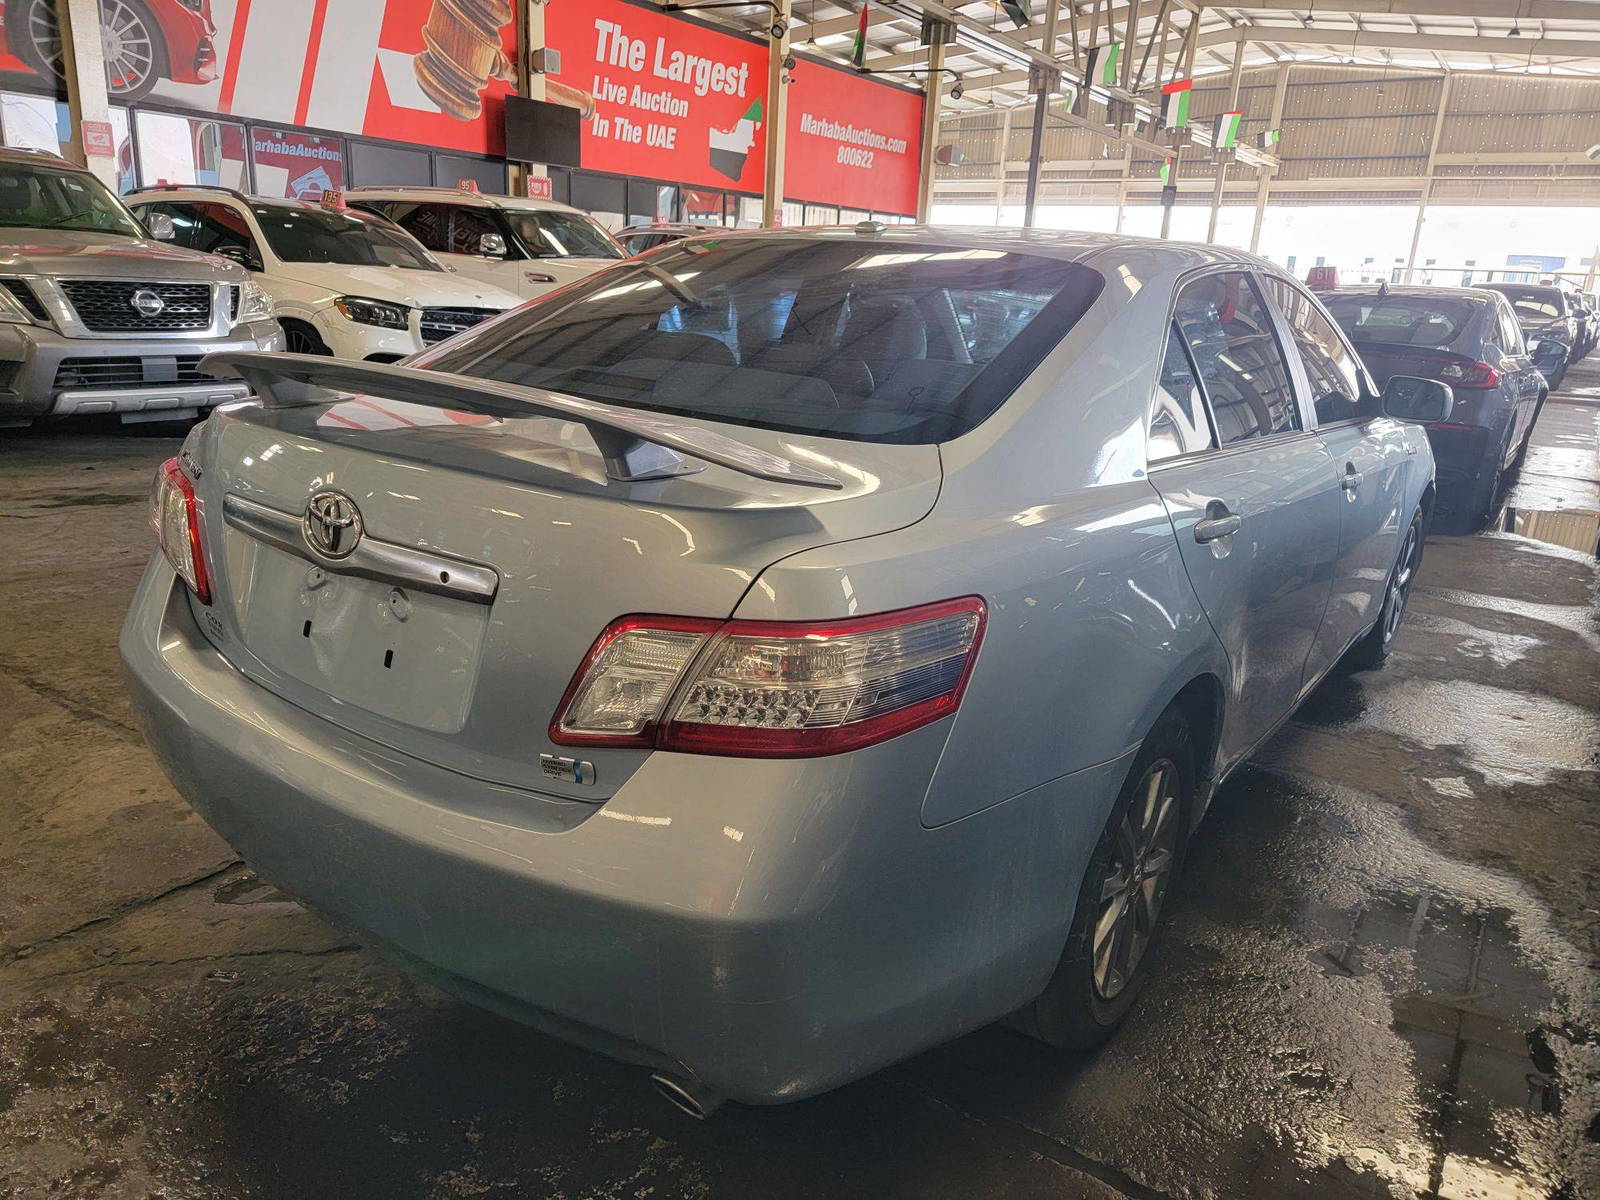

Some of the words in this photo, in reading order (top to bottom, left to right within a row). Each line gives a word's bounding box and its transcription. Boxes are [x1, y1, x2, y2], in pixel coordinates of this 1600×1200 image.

[594, 18, 647, 72] The
[652, 36, 749, 98] Largest
[592, 75, 628, 105] Live
[629, 84, 689, 118] Auction
[591, 112, 610, 138] In
[614, 116, 643, 144] The
[646, 123, 678, 150] UAE
[800, 112, 907, 154] MarhabaAuctions.com
[837, 145, 875, 169] 800622
[323, 190, 339, 203] 135
[461, 180, 471, 191] 95
